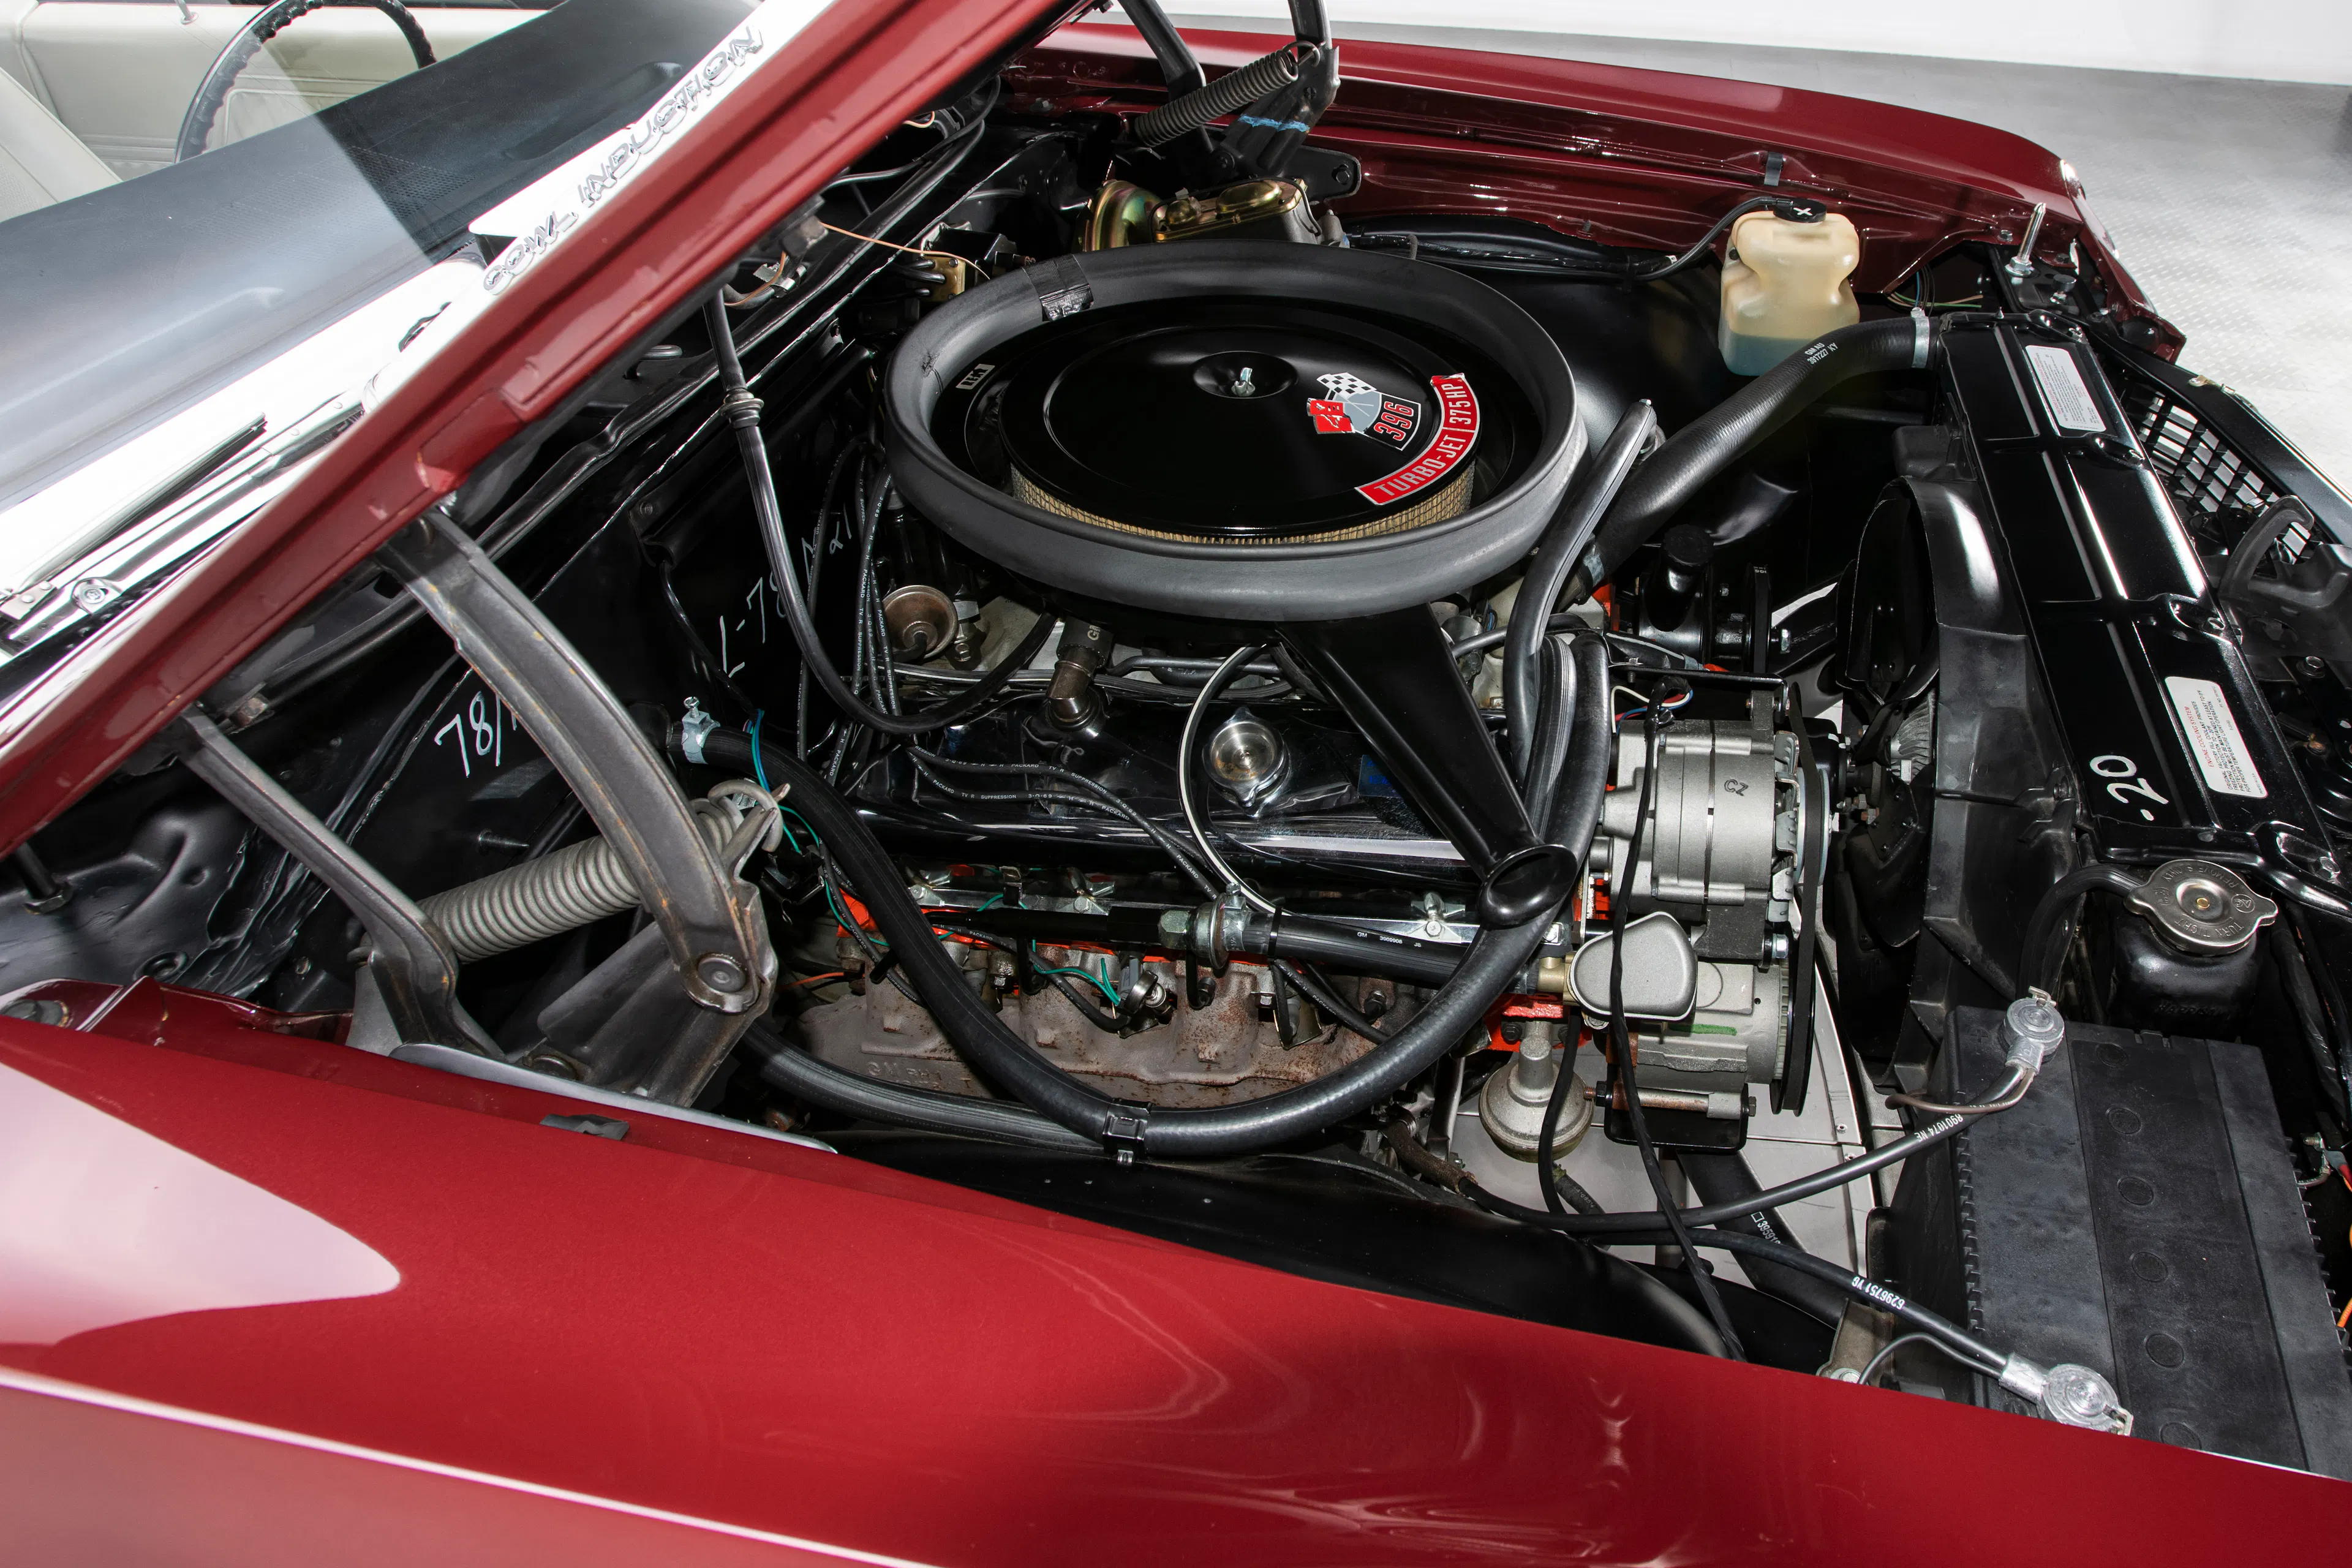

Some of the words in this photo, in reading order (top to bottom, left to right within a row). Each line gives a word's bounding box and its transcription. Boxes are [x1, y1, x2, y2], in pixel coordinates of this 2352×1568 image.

[483, 211, 579, 295] COWL
[578, 24, 764, 208] INDUCTION
[1807, 348, 1829, 364] 3917227
[1827, 342, 1838, 352] KY
[1441, 383, 1465, 399] HP
[1373, 401, 1414, 441] 396
[1449, 400, 1472, 425] 375
[1374, 434, 1466, 497] TURBO-JET
[860, 568, 869, 598] PACKARD
[859, 608, 864, 616] TV
[887, 669, 896, 709] SUPPRESSION
[2185, 707, 2195, 724] SYSTEM
[2192, 702, 2202, 719] PROVIDES
[2193, 726, 2204, 747] COOLING
[2201, 722, 2210, 739] COOLANT
[2211, 722, 2224, 745] MAINTAINED
[2203, 749, 2212, 766] ENGINE
[2213, 752, 2223, 768] FACTORY
[2215, 744, 2228, 768] PROTECTION
[2223, 737, 2238, 764] TEMPERATURE
[829, 750, 842, 776] PACKARD
[2222, 771, 2232, 789] ORIGINAL
[2227, 771, 2237, 790] FREEZING
[2230, 765, 2244, 791] PROTECTION
[2236, 767, 2246, 782] PROPER
[933, 779, 954, 794] PACKARD
[1101, 805, 1130, 821] PACKARD
[1071, 772, 1107, 794] SUPPRESSION
[1177, 854, 1199, 879] PACKARD
[2198, 864, 2239, 888] REMOVE
[2234, 898, 2252, 908] AC
[969, 931, 993, 941] PACKARD
[2174, 917, 2211, 937] TIGHT
[2214, 921, 2244, 937] TURN
[849, 925, 867, 949] PACKARD
[886, 973, 918, 1002] SUPPRESSION
[1914, 1130, 1929, 1142] NE
[1928, 1114, 1964, 1136] 8901074
[1852, 1276, 1865, 1291] YG
[1865, 1282, 1905, 1310] 6296751
